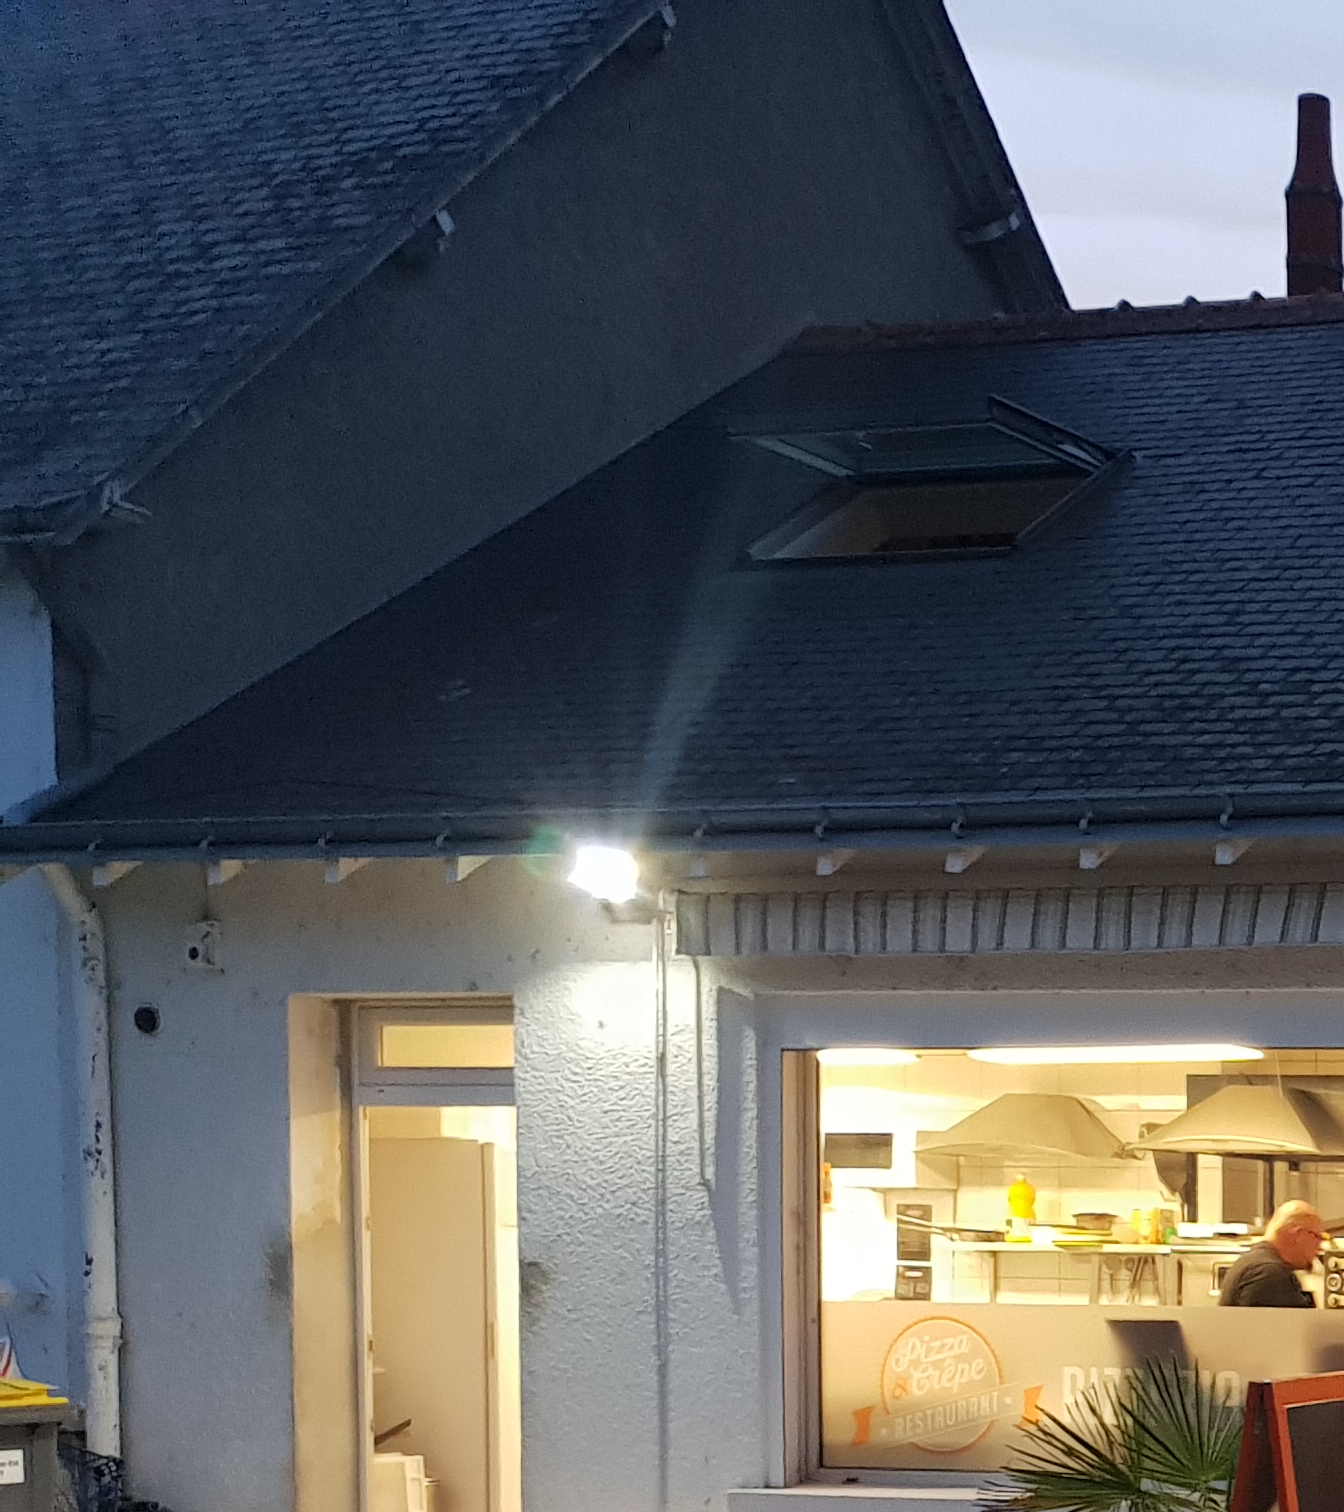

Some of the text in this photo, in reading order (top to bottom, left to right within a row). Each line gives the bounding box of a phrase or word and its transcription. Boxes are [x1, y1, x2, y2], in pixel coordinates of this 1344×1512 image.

[891, 1334, 972, 1372] Pizza
[909, 1357, 988, 1396] Crêpe
[894, 1391, 999, 1439] RESTAURANT
